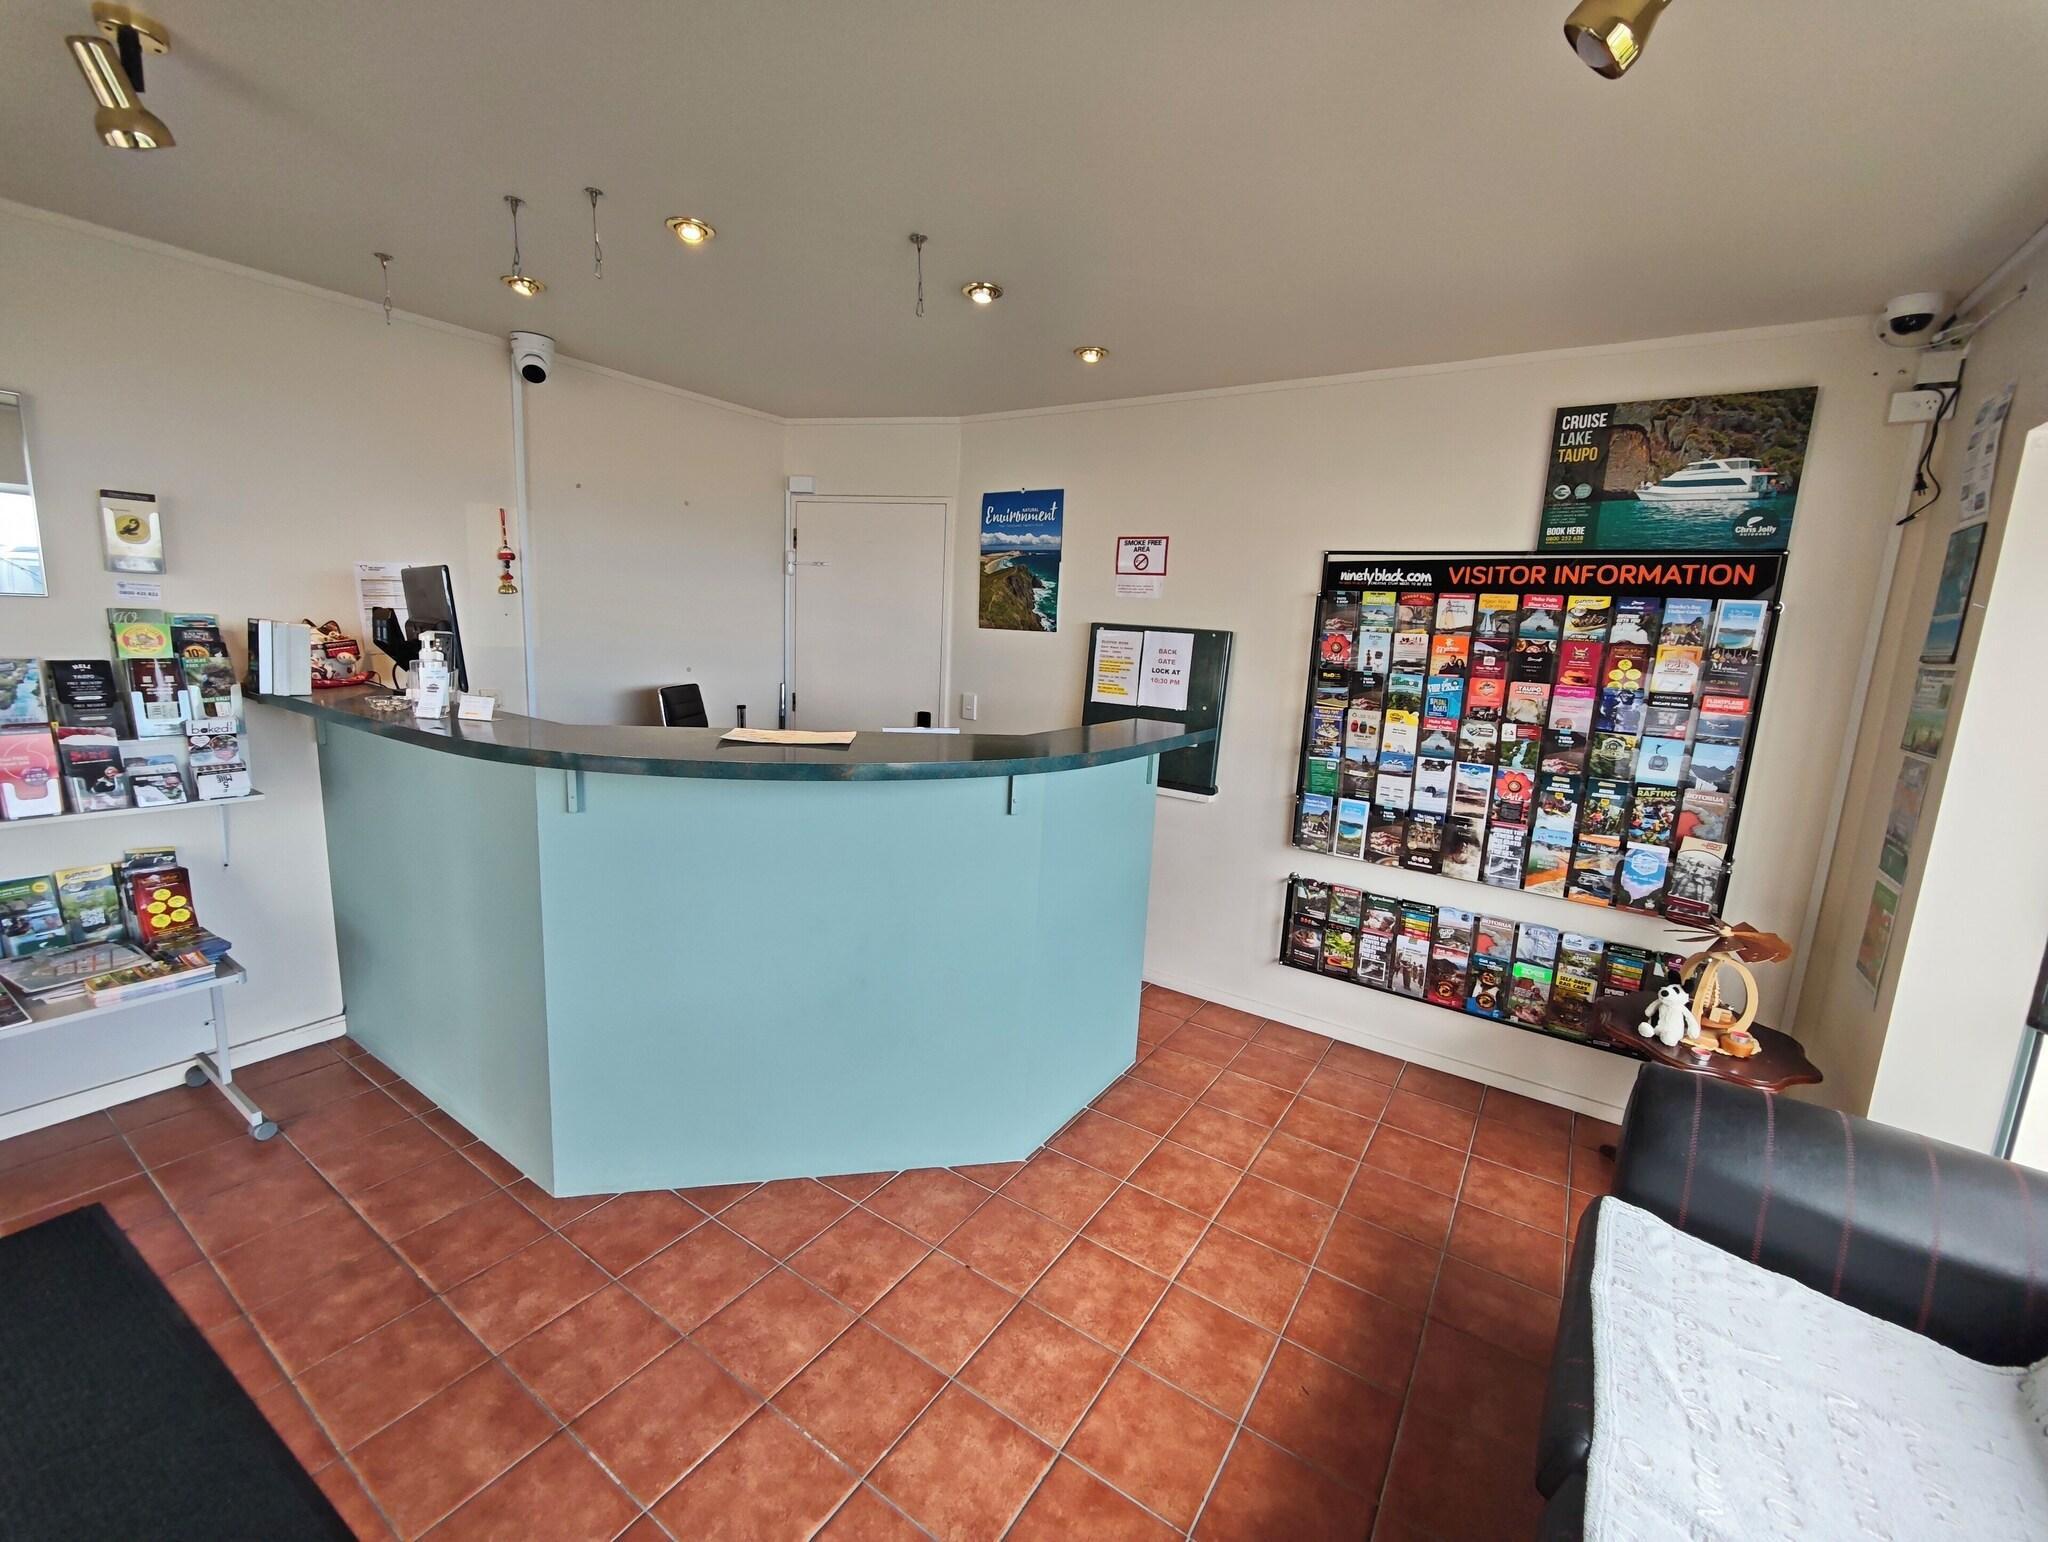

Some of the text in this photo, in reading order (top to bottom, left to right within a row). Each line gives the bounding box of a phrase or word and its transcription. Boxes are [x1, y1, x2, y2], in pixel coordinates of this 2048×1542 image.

[1562, 413, 1609, 430] CRUISE
[1560, 430, 1593, 447] LAKE
[1558, 446, 1598, 463] TAUPO
[985, 500, 1059, 525] Environment
[1546, 526, 1586, 536] BOOK HERE
[1757, 526, 1777, 534] Jolly
[1340, 567, 1432, 585] ninetyblack.com
[1448, 563, 1756, 586] VISITOR INFORMATION
[1637, 790, 1677, 798] RAFTING
[1686, 793, 1725, 803] ROTORUA
[1559, 975, 1592, 987] SELF-DRIVE
